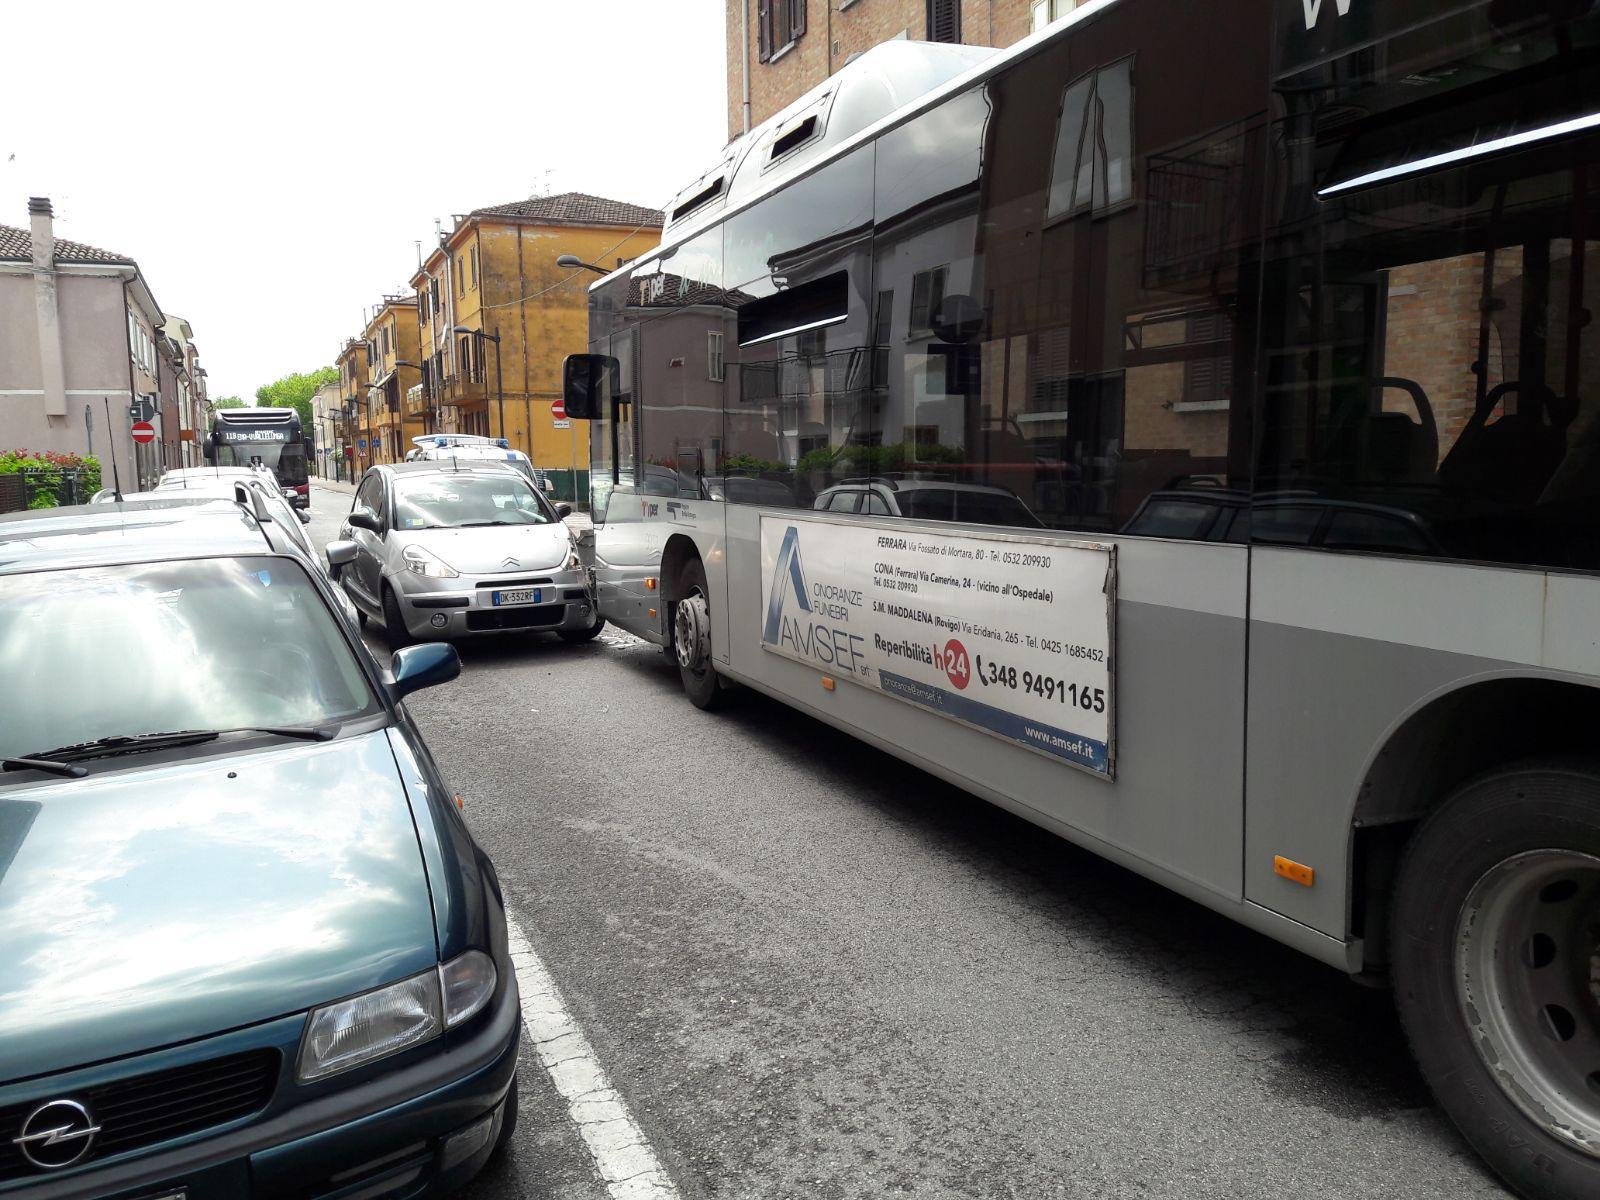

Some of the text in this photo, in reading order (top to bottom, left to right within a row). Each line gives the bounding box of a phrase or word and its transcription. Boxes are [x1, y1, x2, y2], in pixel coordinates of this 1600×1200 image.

[877, 536, 907, 550] FERRARA
[908, 541, 917, 552] Via
[918, 542, 940, 555] Fossato
[940, 545, 947, 556] di
[948, 546, 974, 560] Mortara,
[975, 548, 985, 560] 80
[990, 550, 1001, 562] Tel.
[1003, 552, 1021, 565] 0532
[1022, 554, 1051, 569] 209930
[813, 582, 863, 607] ONORANZE
[874, 562, 894, 576] CONA
[895, 567, 919, 580] (Ferrara)
[919, 570, 929, 582] Via
[930, 572, 961, 588] Camerina,
[962, 577, 971, 588] 24
[977, 580, 1000, 593] (vicino
[1001, 583, 1054, 604] all'Ospedale)
[883, 578, 896, 590] 0532
[897, 580, 918, 593] 209930
[814, 600, 849, 622] FUNEBRI
[780, 615, 865, 673] AMSEF
[873, 601, 886, 614] S.M.
[887, 603, 933, 625] MADDALENA
[934, 616, 961, 633] (Rovigo)
[961, 621, 972, 633] Via
[1005, 630, 1019, 644] 265
[1025, 635, 1039, 649] Tel.
[1041, 638, 1062, 654] 0425
[1064, 643, 1104, 662] 1685452
[874, 632, 933, 665] Reperibilità
[988, 661, 1018, 690] 348
[1022, 670, 1106, 714] 9491165
[1024, 724, 1094, 759] www.amsef.it
